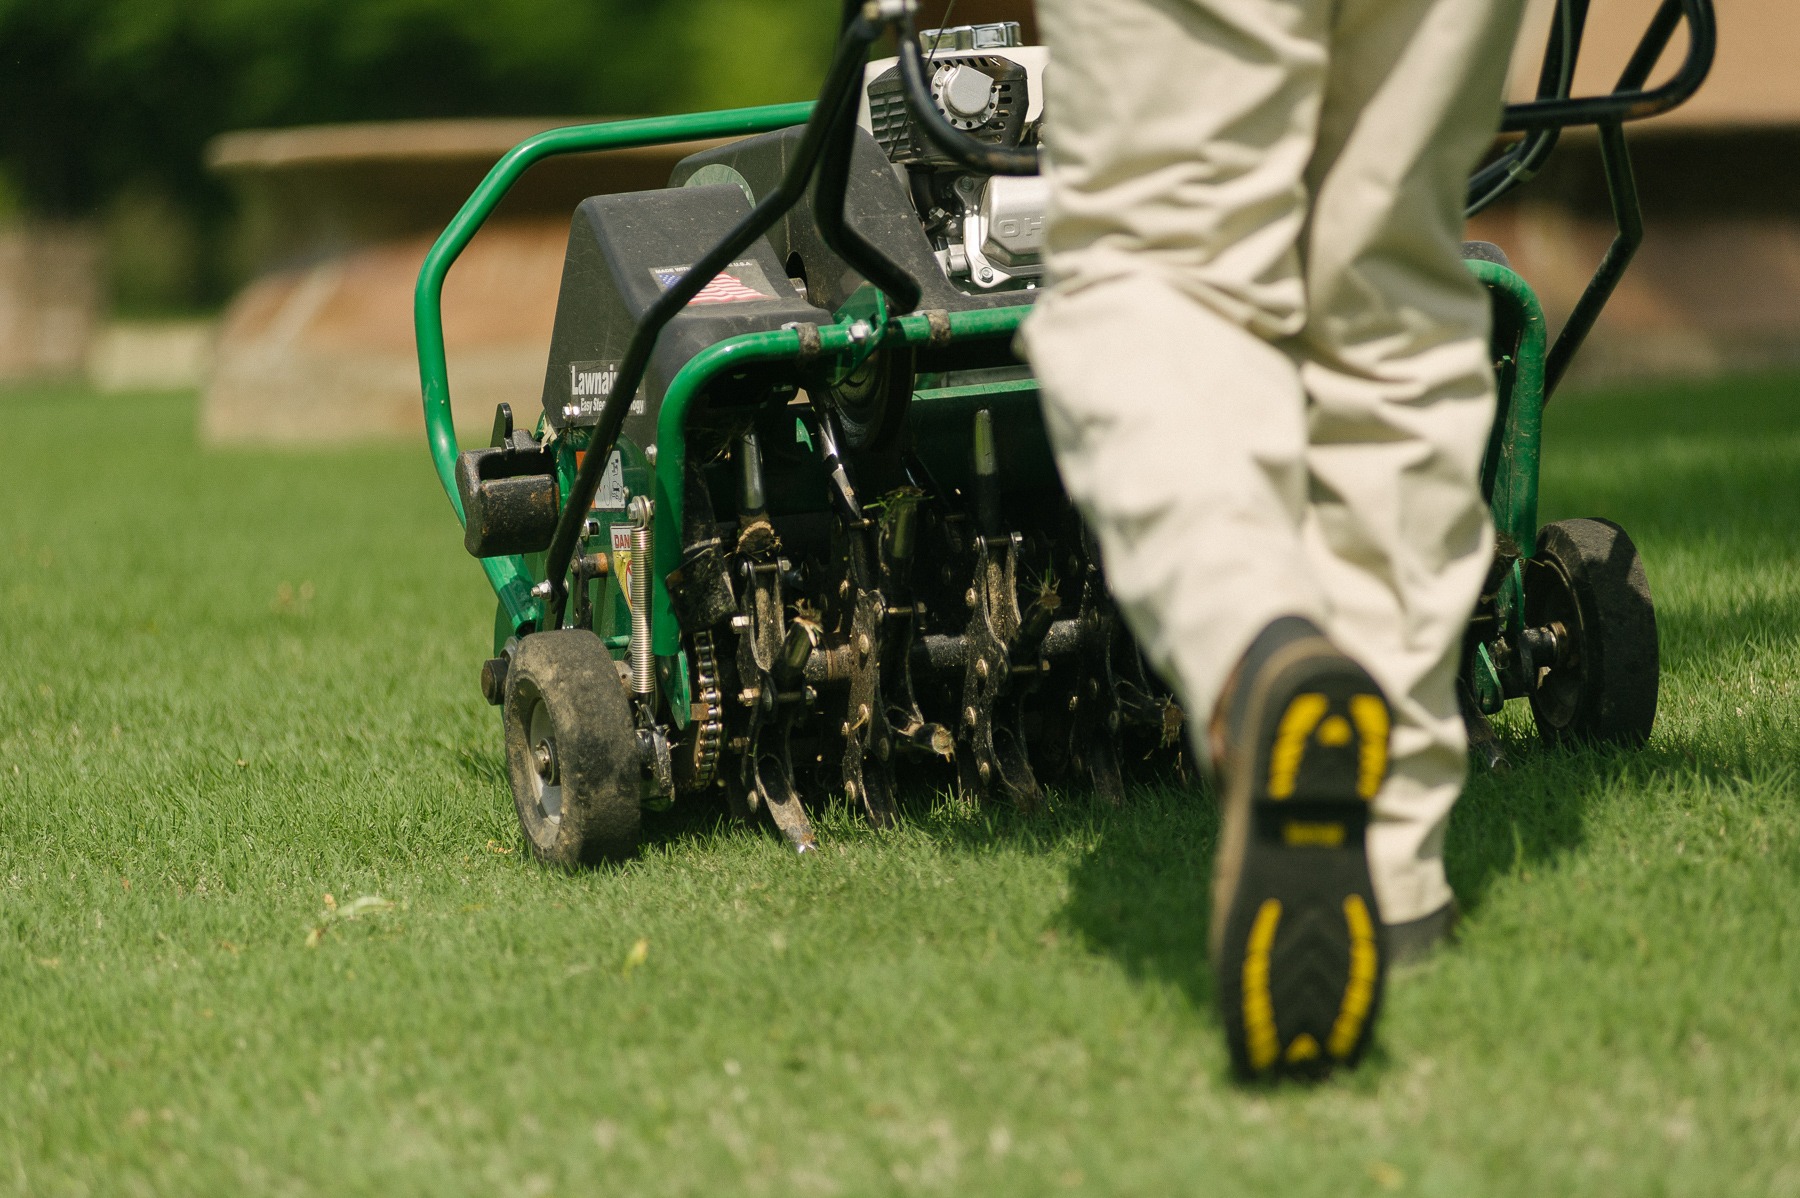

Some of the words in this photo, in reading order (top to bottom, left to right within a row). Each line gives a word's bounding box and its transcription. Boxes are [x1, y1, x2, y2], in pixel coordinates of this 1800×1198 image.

[999, 216, 1045, 238] OH
[580, 398, 593, 415] Easy
[614, 534, 631, 549] DAN
